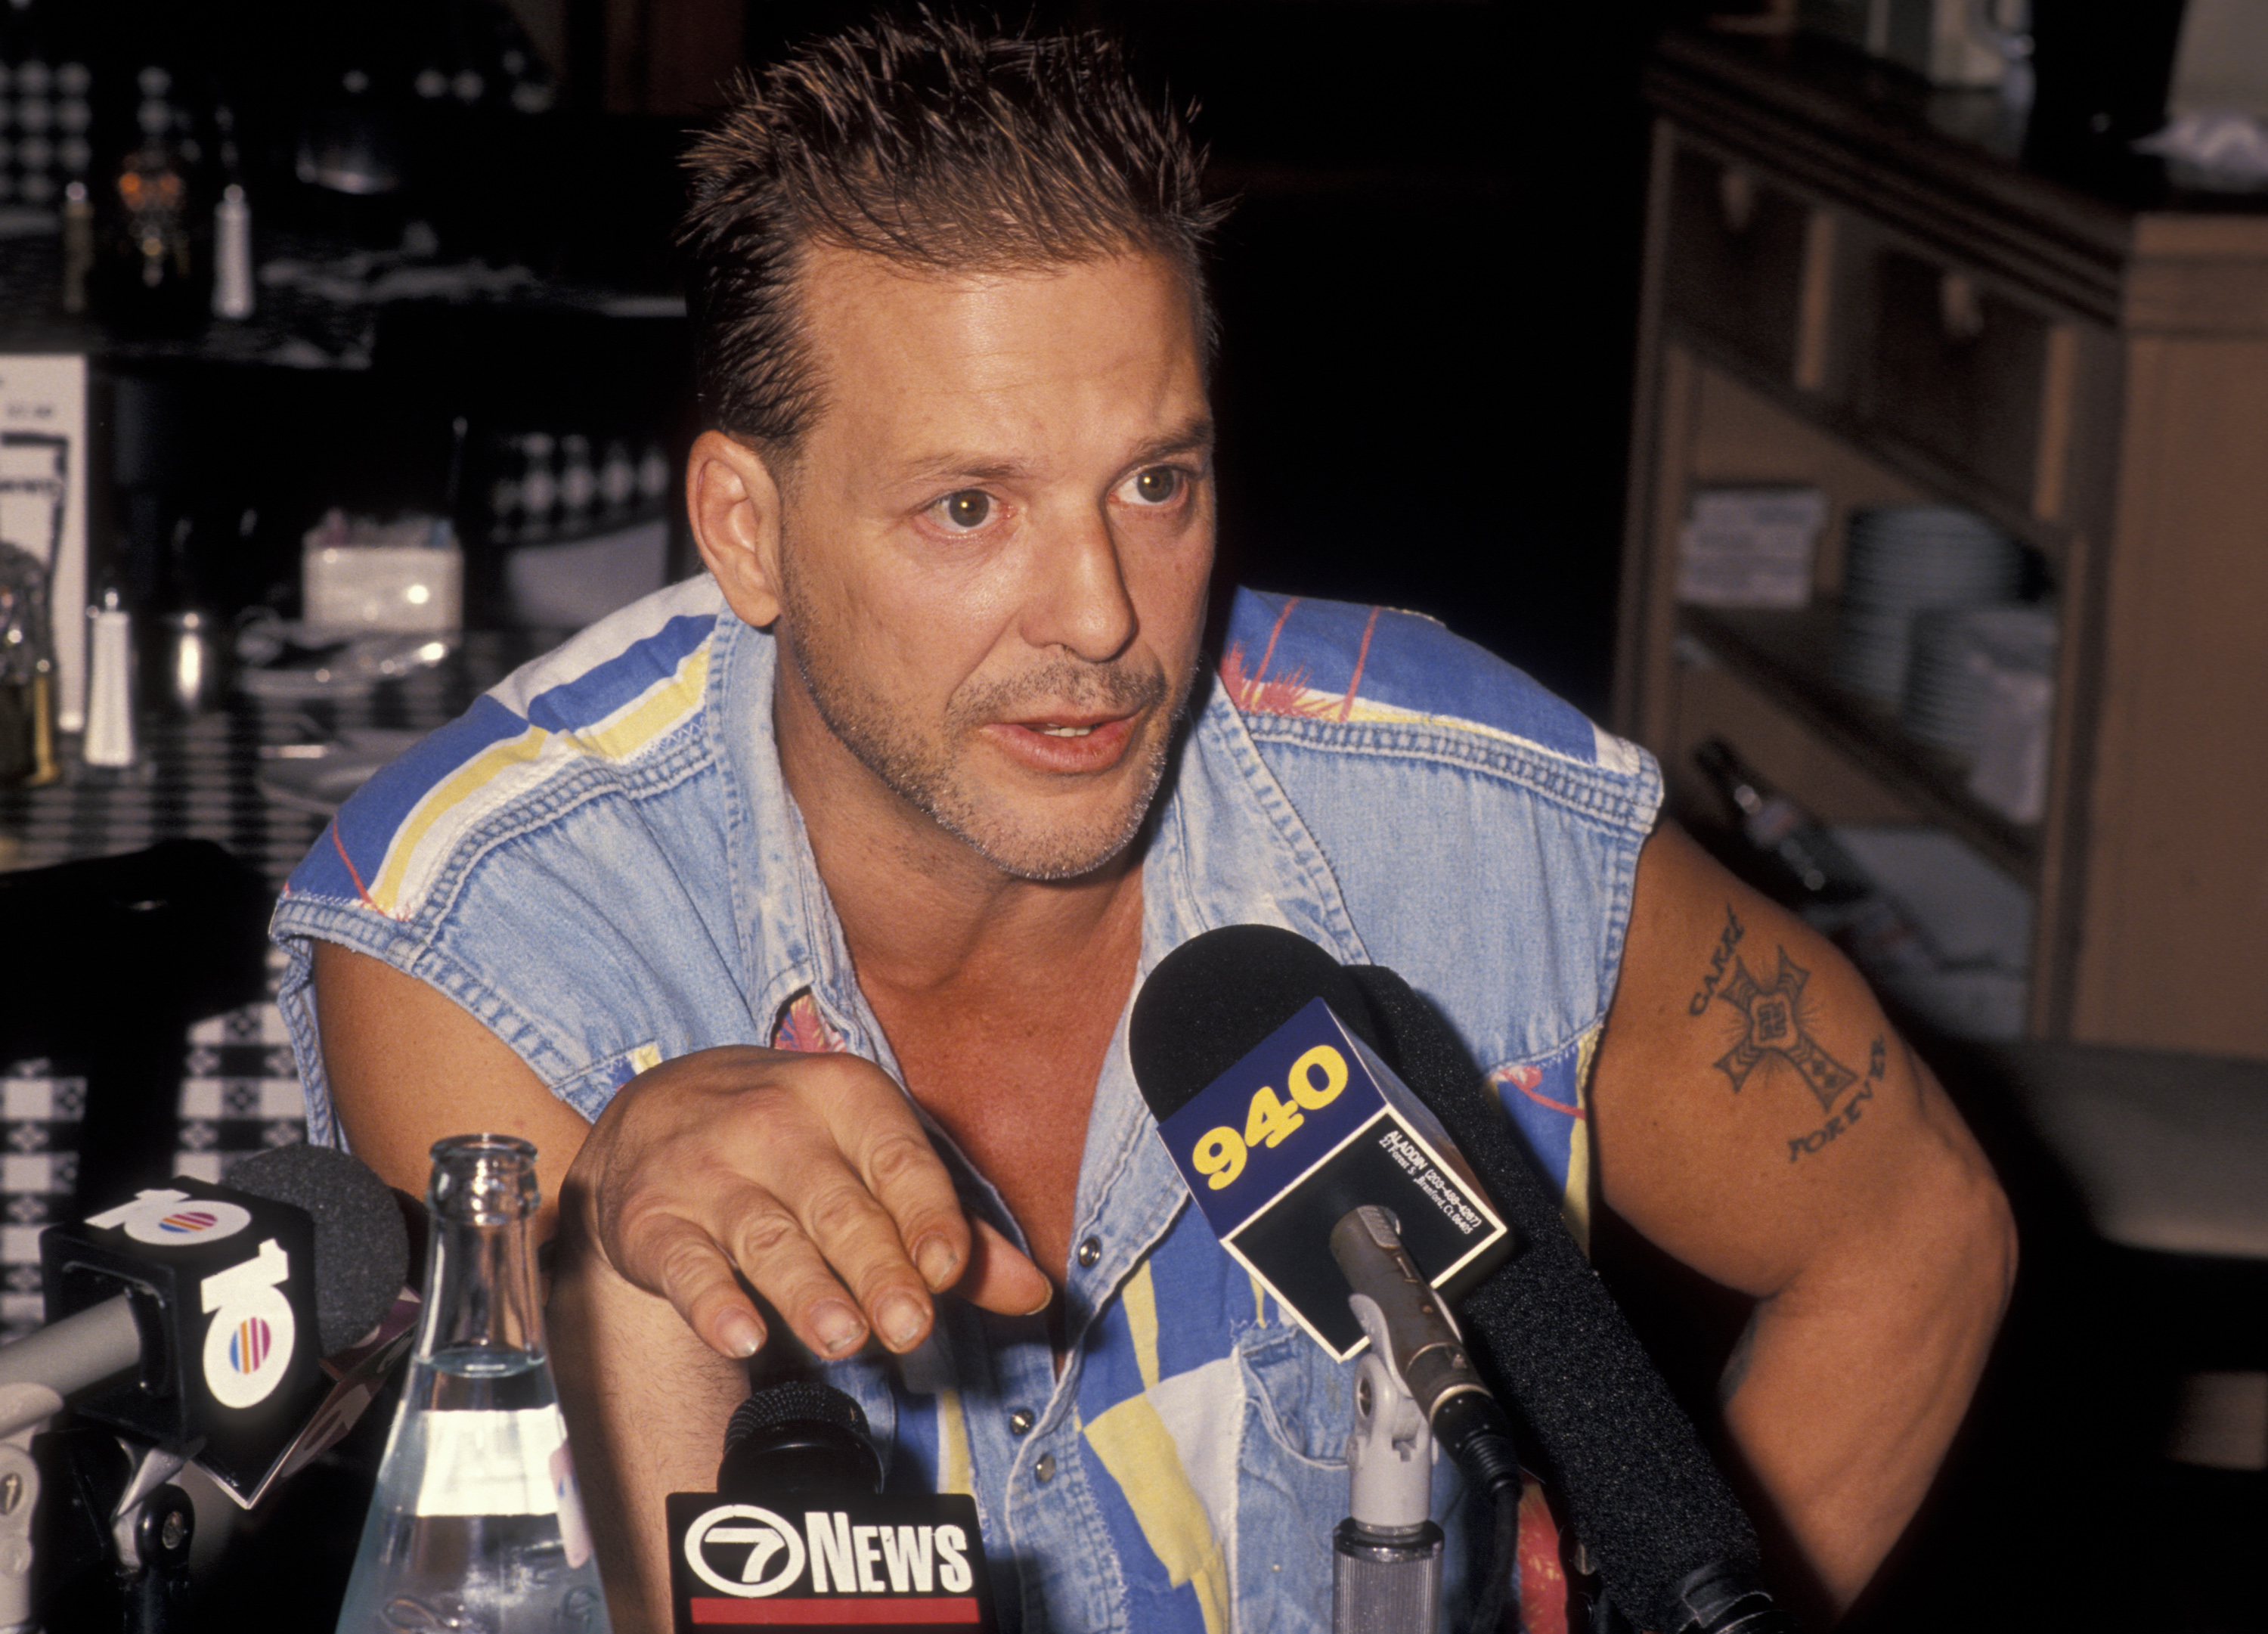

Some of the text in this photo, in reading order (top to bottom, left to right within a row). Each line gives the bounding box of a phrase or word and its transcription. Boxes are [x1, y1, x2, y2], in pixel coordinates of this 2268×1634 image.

[1192, 1045, 1349, 1190] 940
[1387, 1130, 1427, 1170] ALADDIN
[84, 1189, 252, 1245] 10
[200, 1238, 296, 1409] 10
